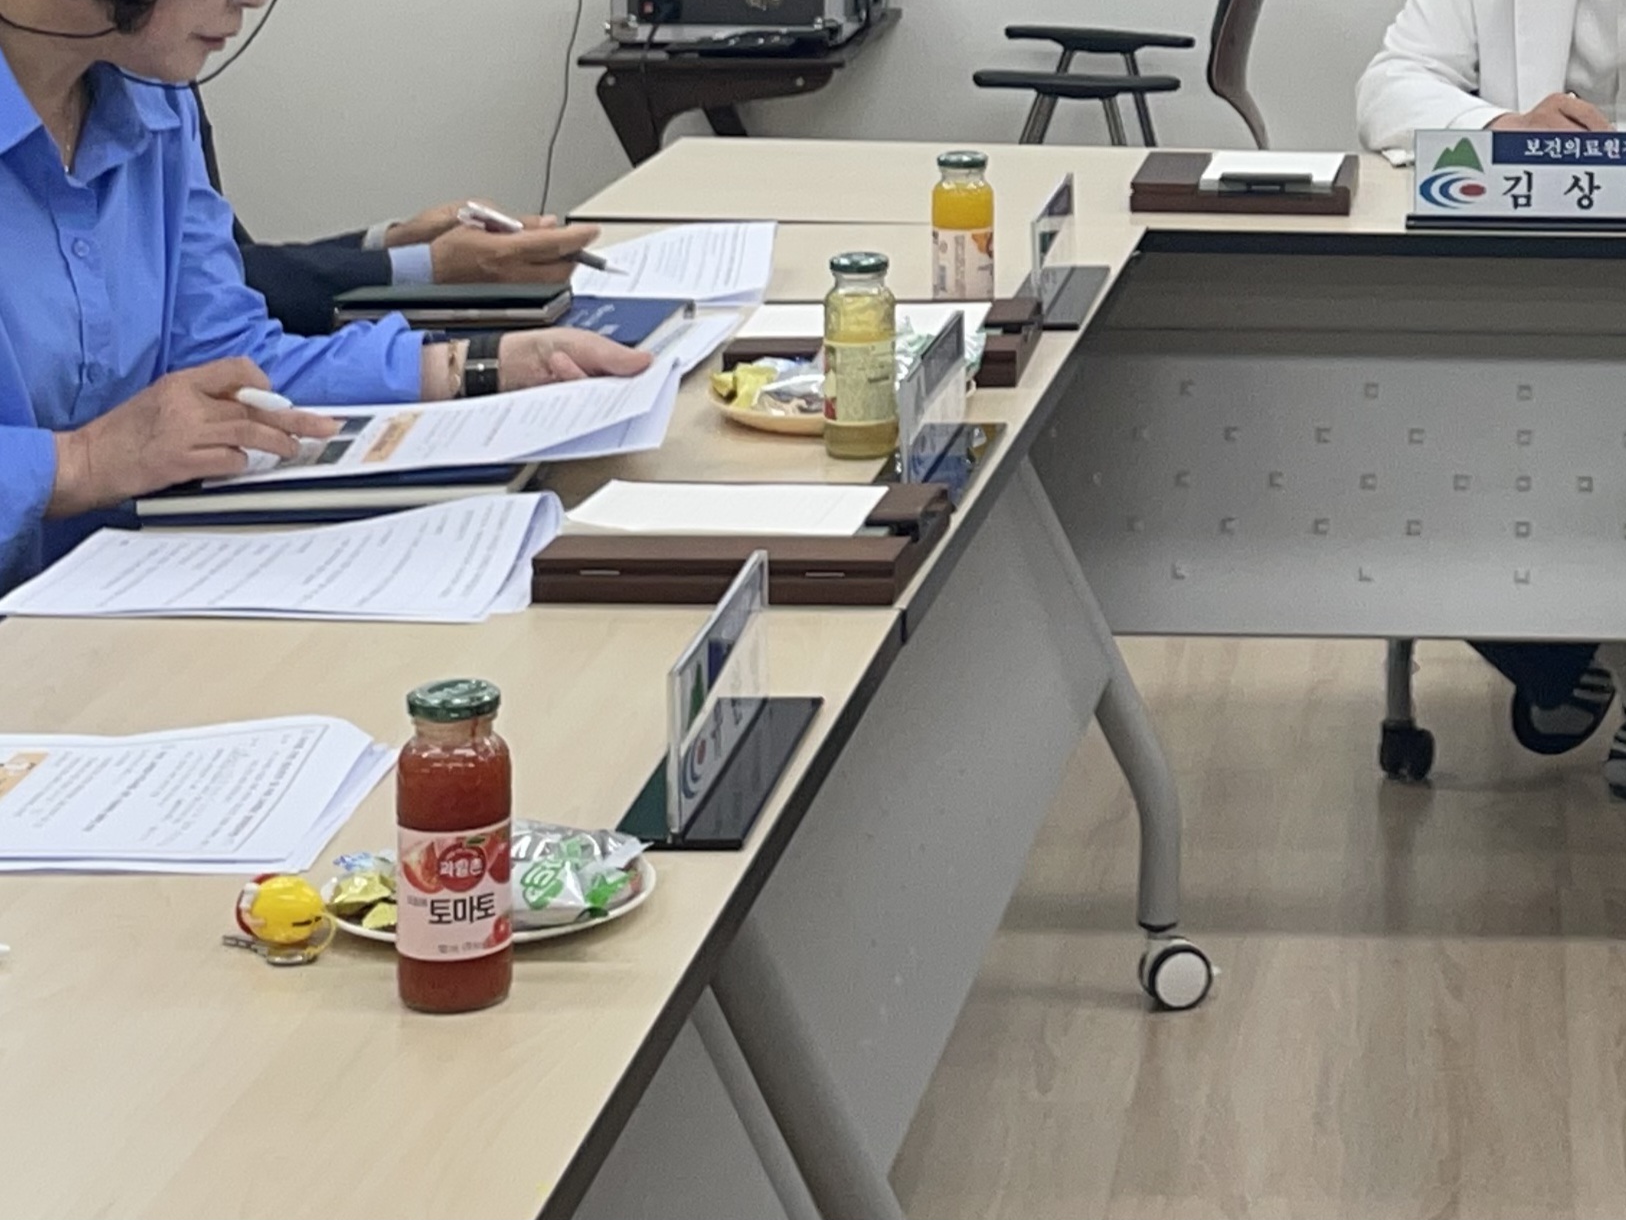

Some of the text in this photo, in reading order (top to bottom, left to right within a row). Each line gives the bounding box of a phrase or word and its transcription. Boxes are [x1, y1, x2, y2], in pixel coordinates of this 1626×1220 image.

[1502, 170, 1533, 210] 김
[1564, 170, 1602, 210] 상
[428, 892, 496, 925] 토마토
